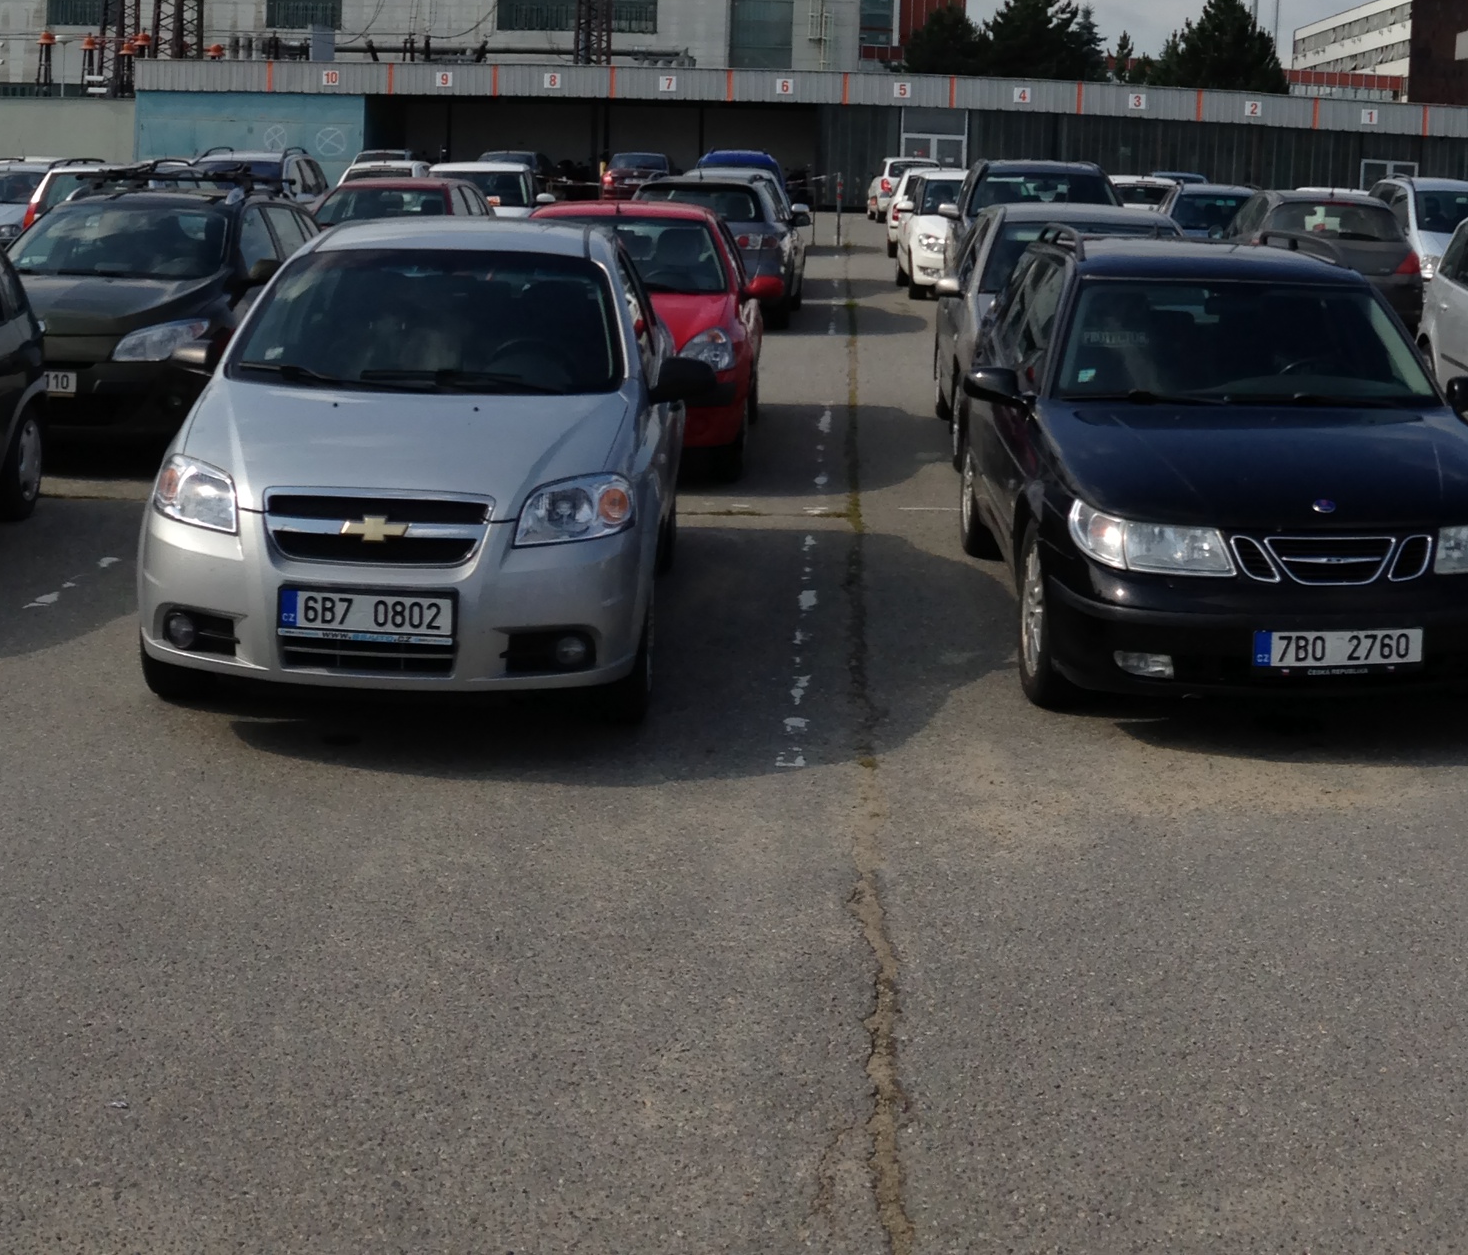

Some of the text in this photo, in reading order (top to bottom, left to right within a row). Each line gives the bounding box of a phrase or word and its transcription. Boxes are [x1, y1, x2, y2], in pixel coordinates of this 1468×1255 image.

[324, 70, 339, 85] 10
[440, 73, 449, 86] 9
[548, 74, 558, 87] 8
[664, 77, 674, 90] 7
[780, 79, 790, 93] 6
[898, 83, 907, 97] 5
[1018, 88, 1028, 102] 4
[1133, 95, 1142, 109] 3
[1249, 102, 1258, 115] 2
[1367, 110, 1375, 123] 1
[304, 596, 354, 625] 6B7
[373, 600, 441, 630] 0802
[1278, 635, 1326, 663] 7B0
[1347, 633, 1410, 661] 2760
